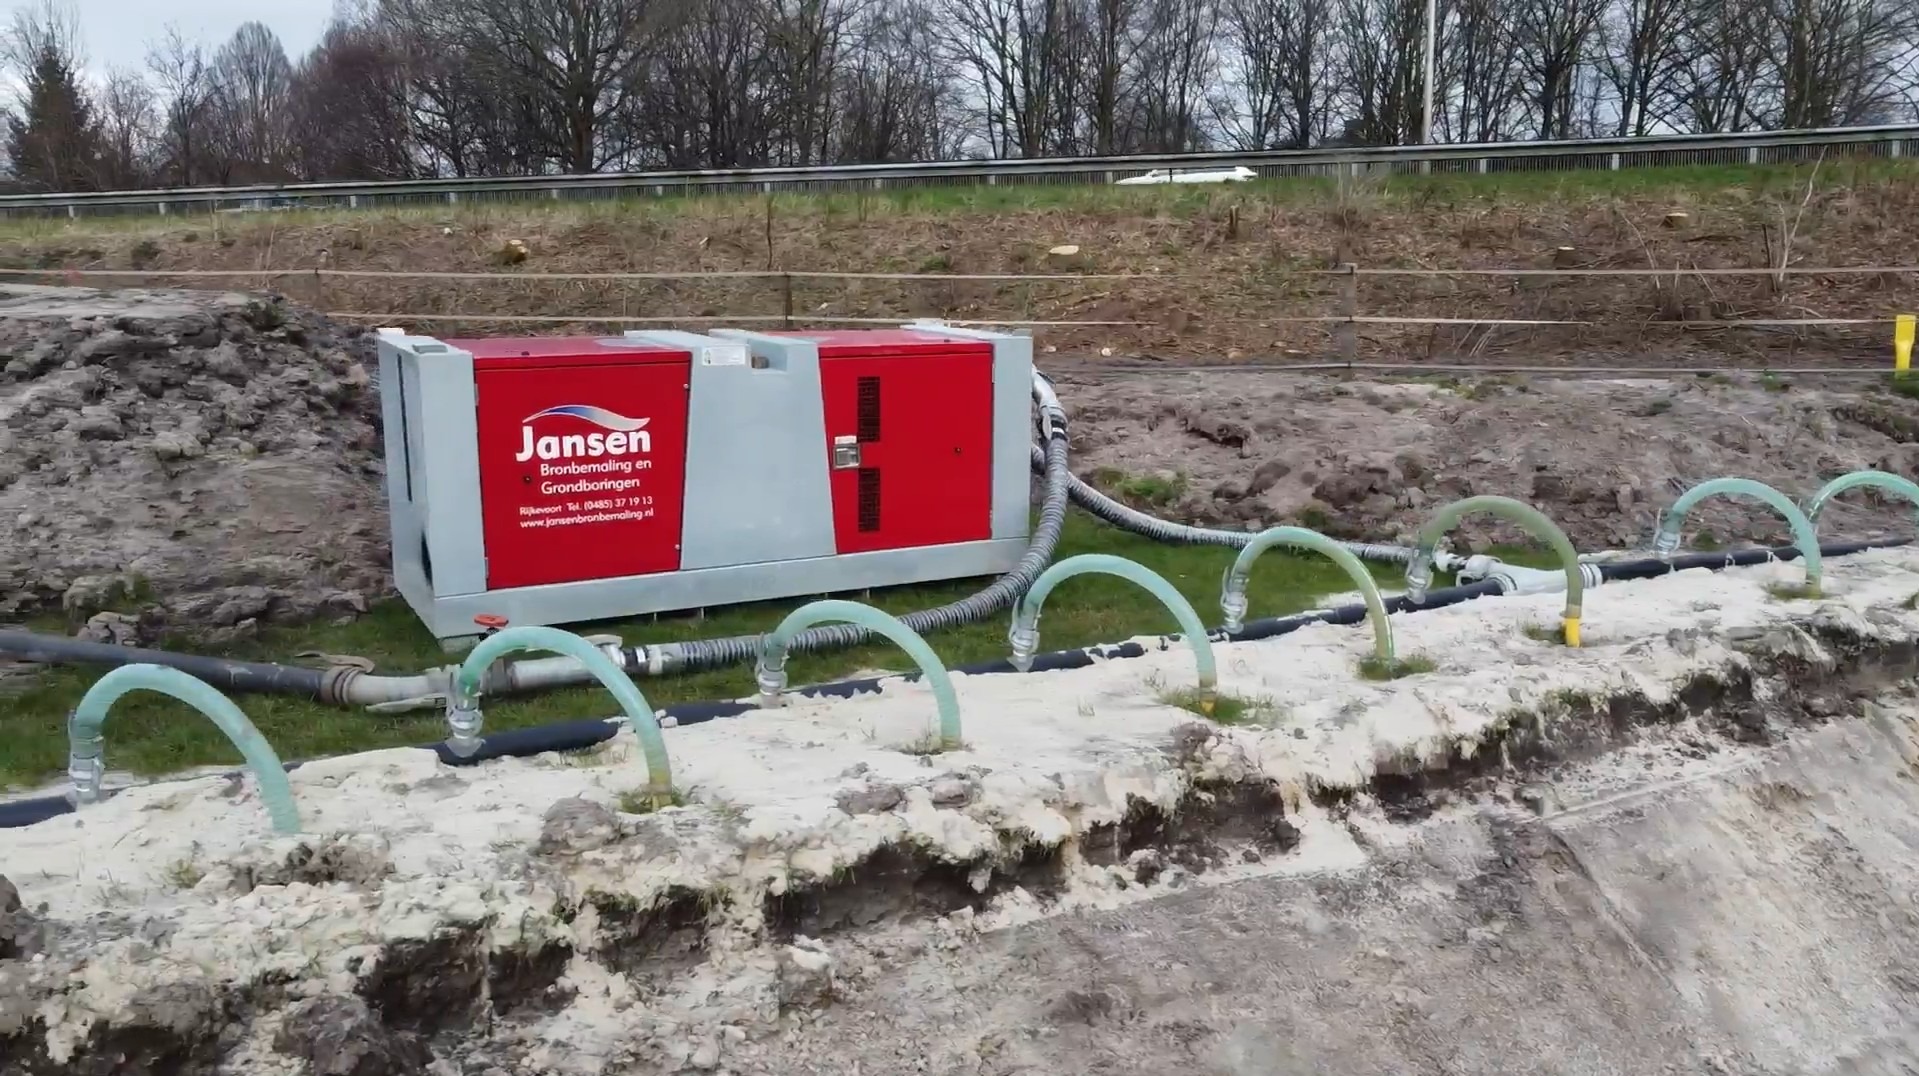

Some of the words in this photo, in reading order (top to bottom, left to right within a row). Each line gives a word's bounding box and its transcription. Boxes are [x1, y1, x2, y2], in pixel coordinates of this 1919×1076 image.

[515, 425, 651, 462] Jansen
[540, 460, 632, 476] Bronbemaling
[635, 459, 652, 469] en
[541, 478, 640, 494] Grondboringen
[519, 505, 562, 516] Rijkevoort
[566, 501, 582, 511] Tel.
[584, 499, 613, 511] (0485)
[614, 498, 627, 507] 37
[629, 496, 640, 506] 19
[642, 495, 653, 505] 13
[519, 507, 654, 528] www.jansenbronbemaling.nl
